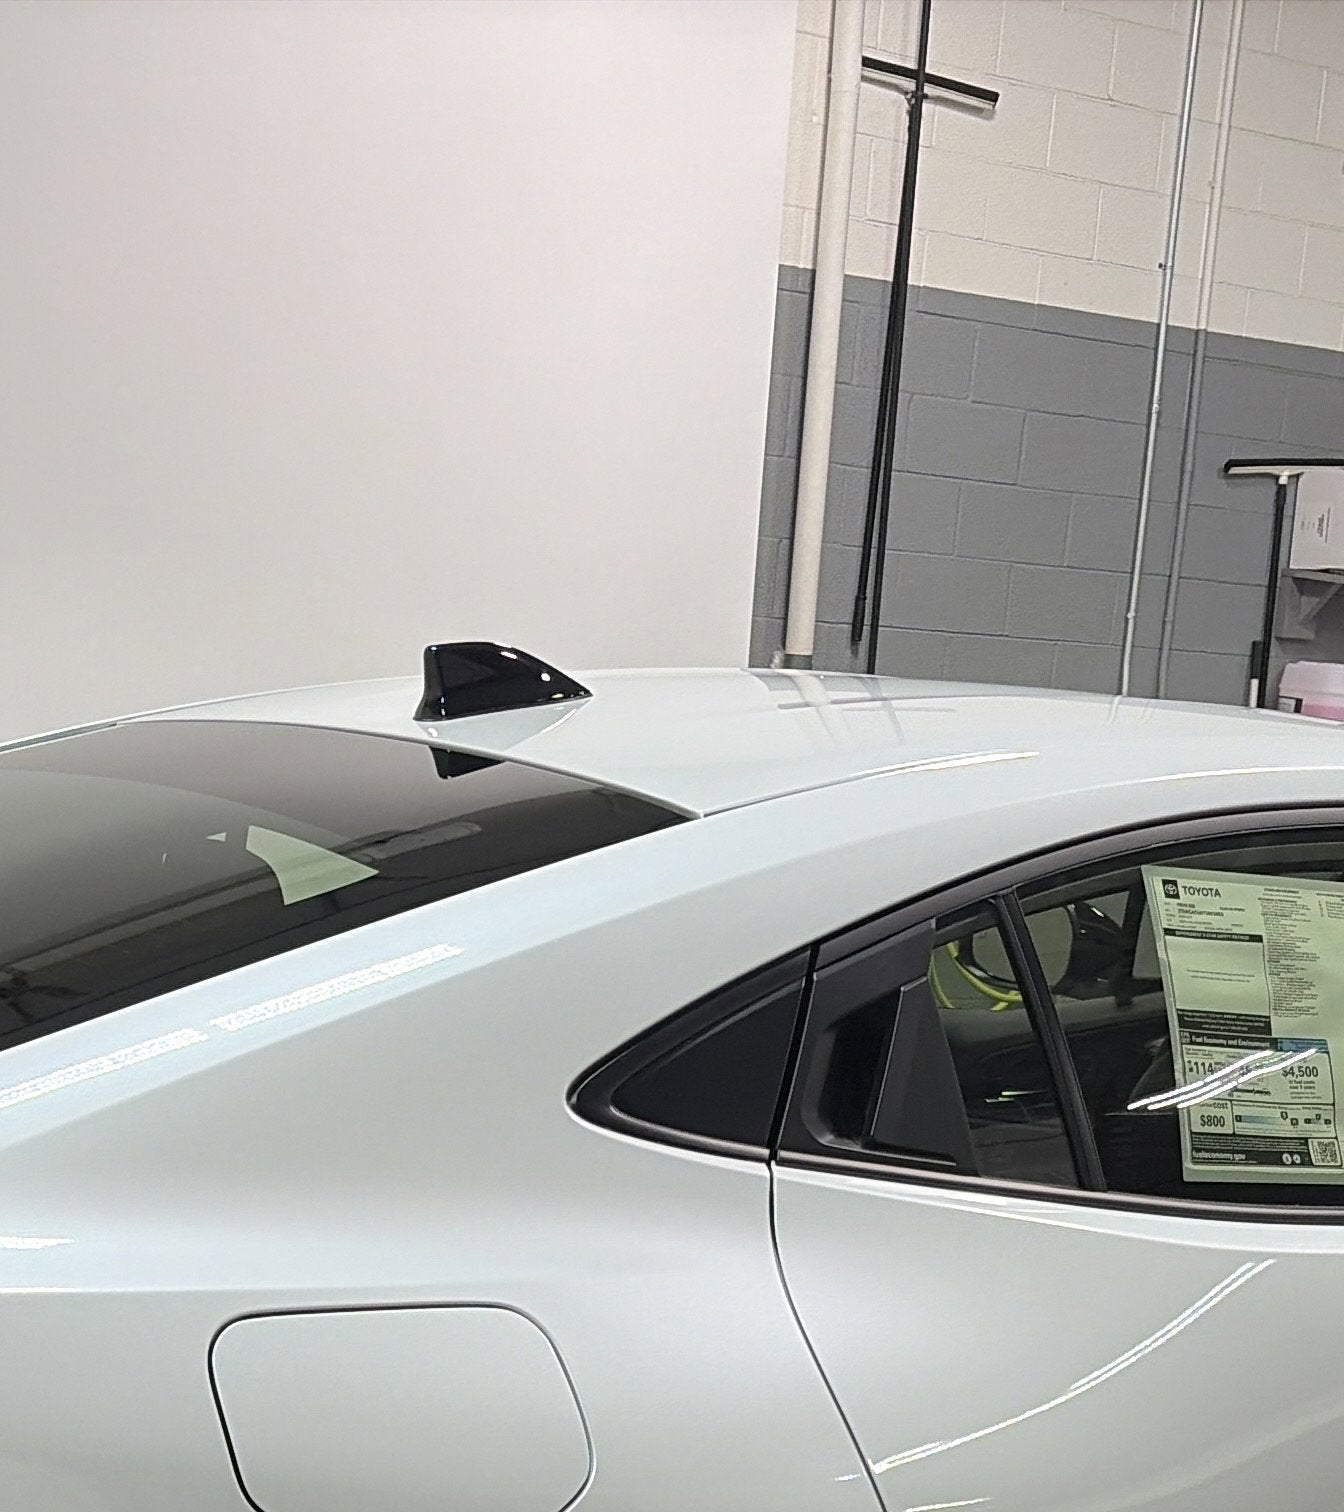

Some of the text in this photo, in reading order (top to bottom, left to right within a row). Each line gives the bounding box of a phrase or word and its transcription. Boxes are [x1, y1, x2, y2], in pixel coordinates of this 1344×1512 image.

[1181, 885, 1222, 898] TOYOTA
[1193, 1061, 1214, 1075] 114
[1281, 1066, 1319, 1080] $4,500
[1199, 1114, 1226, 1128] $800
